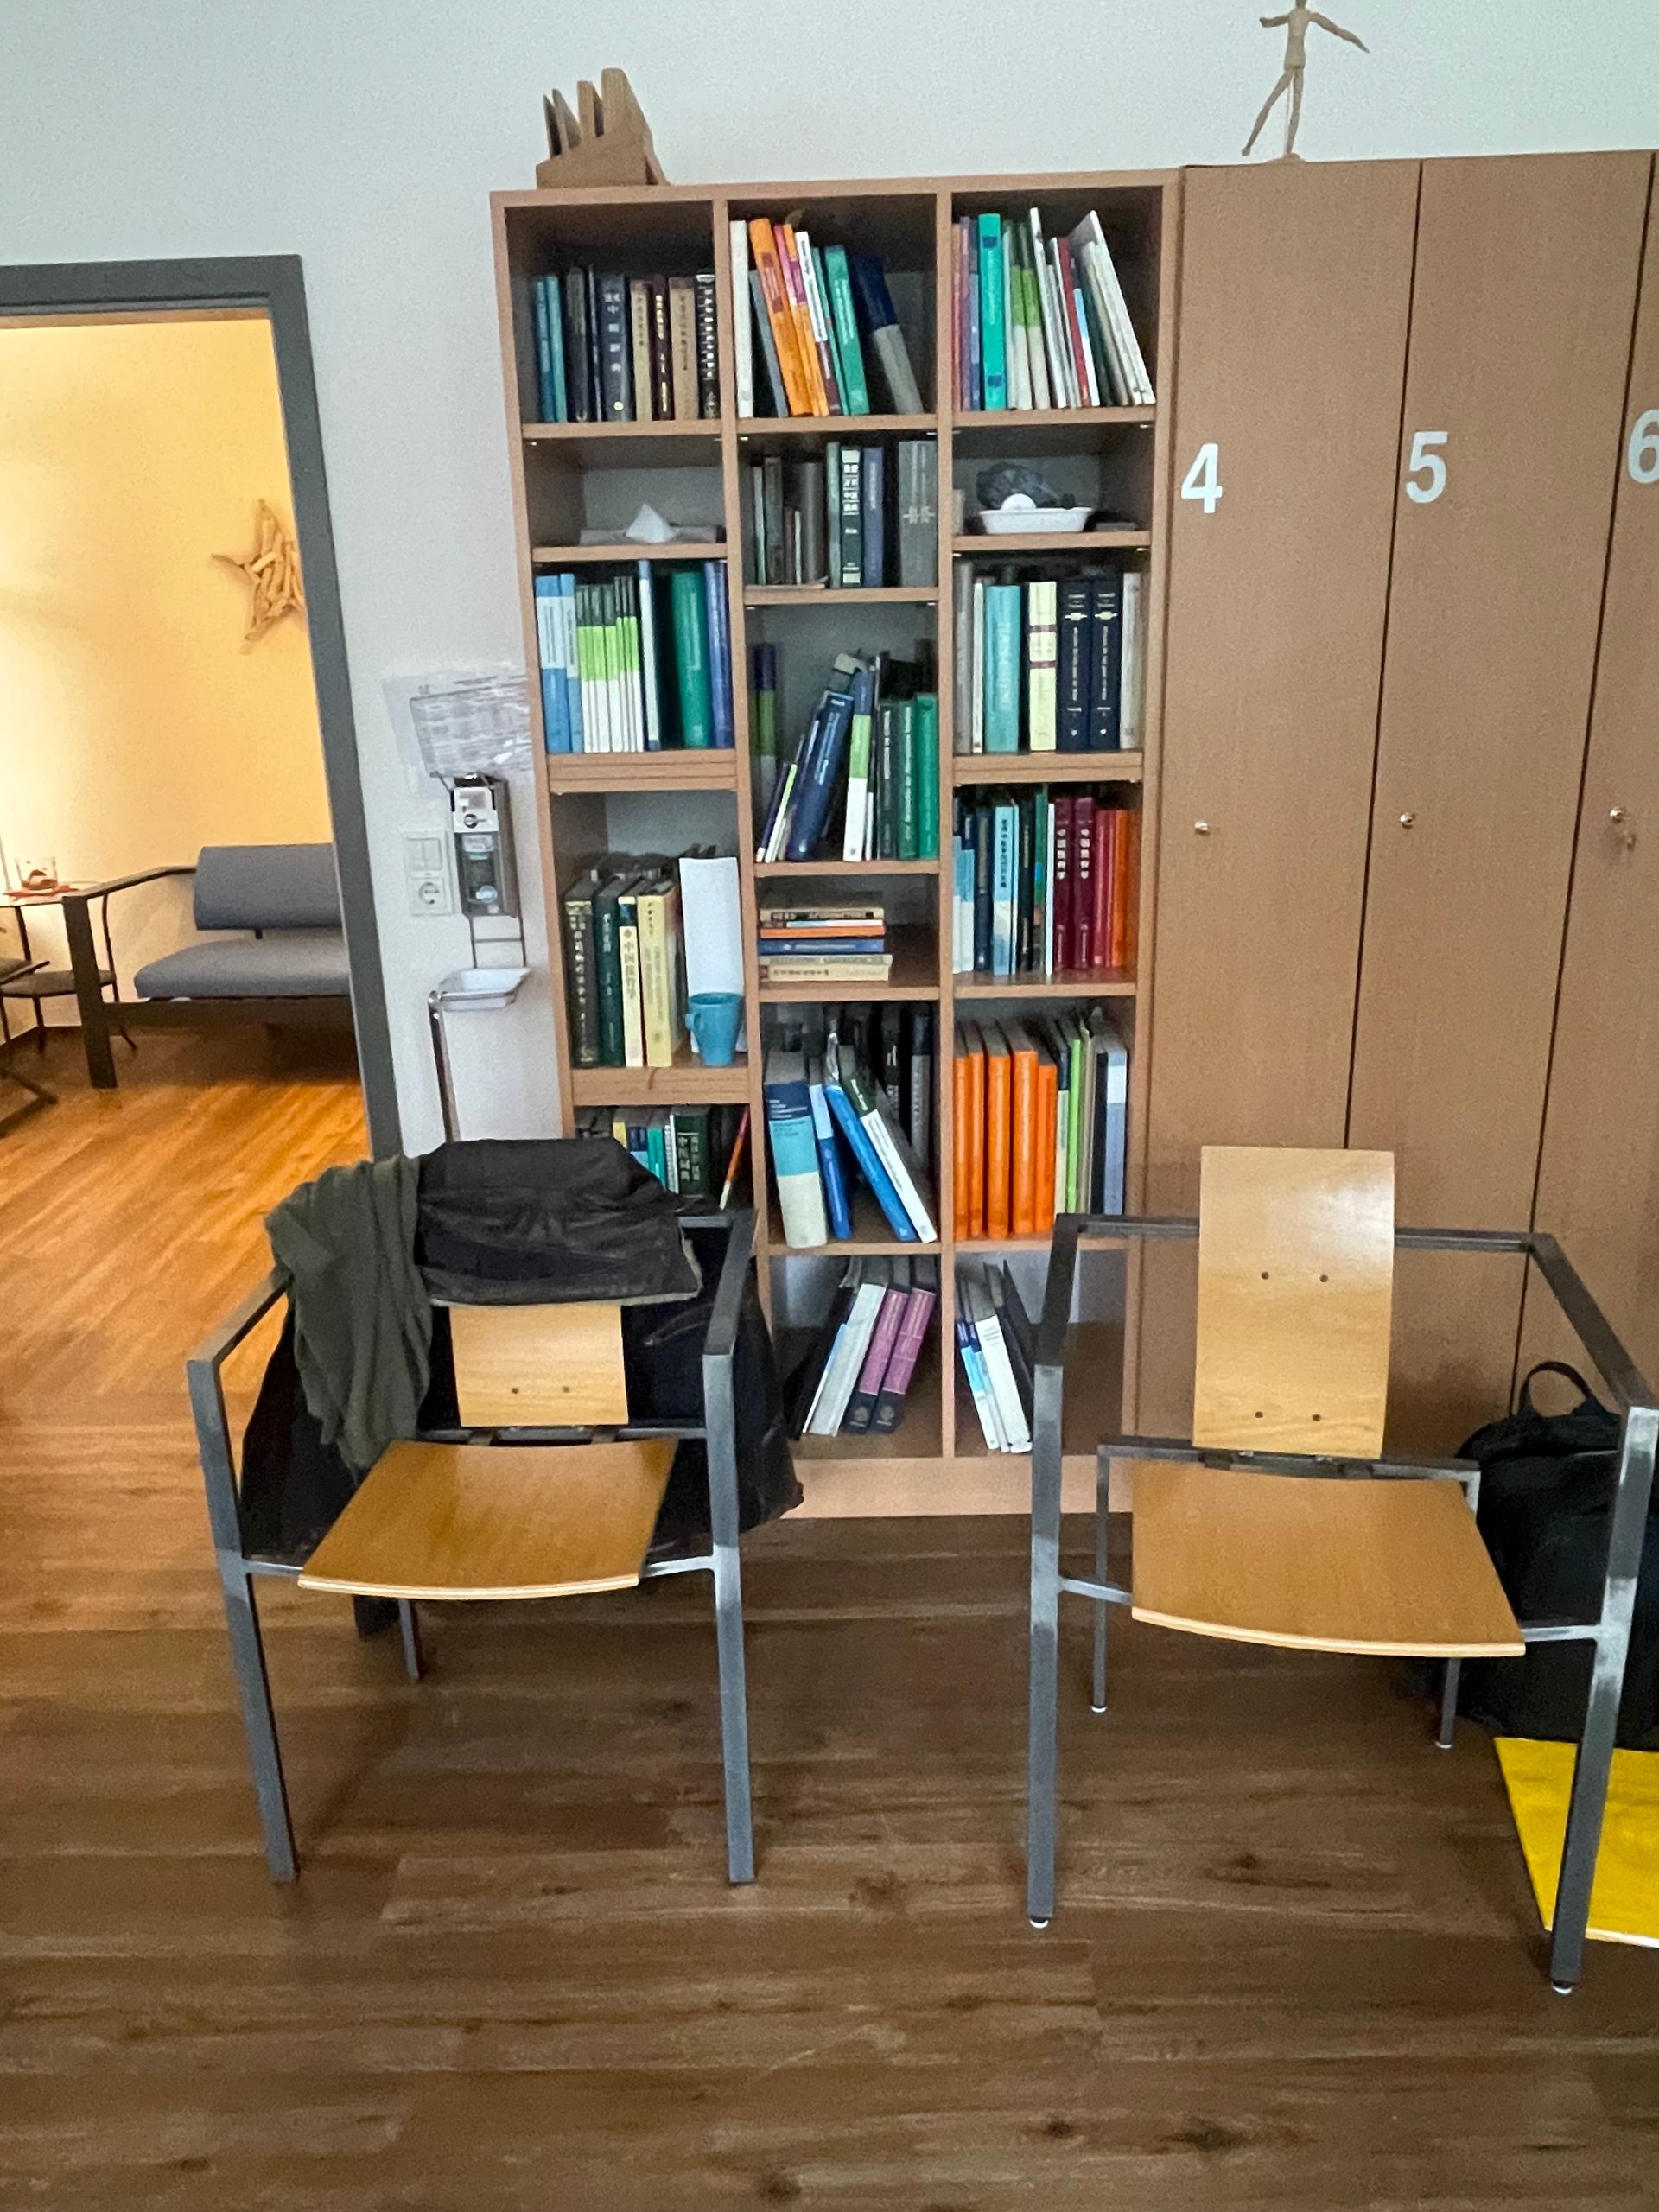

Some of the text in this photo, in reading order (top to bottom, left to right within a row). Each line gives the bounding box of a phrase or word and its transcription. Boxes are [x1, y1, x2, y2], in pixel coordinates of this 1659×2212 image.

[1180, 443, 1224, 514] 4
[1406, 431, 1449, 504] 5
[1627, 409, 1659, 484] 6
